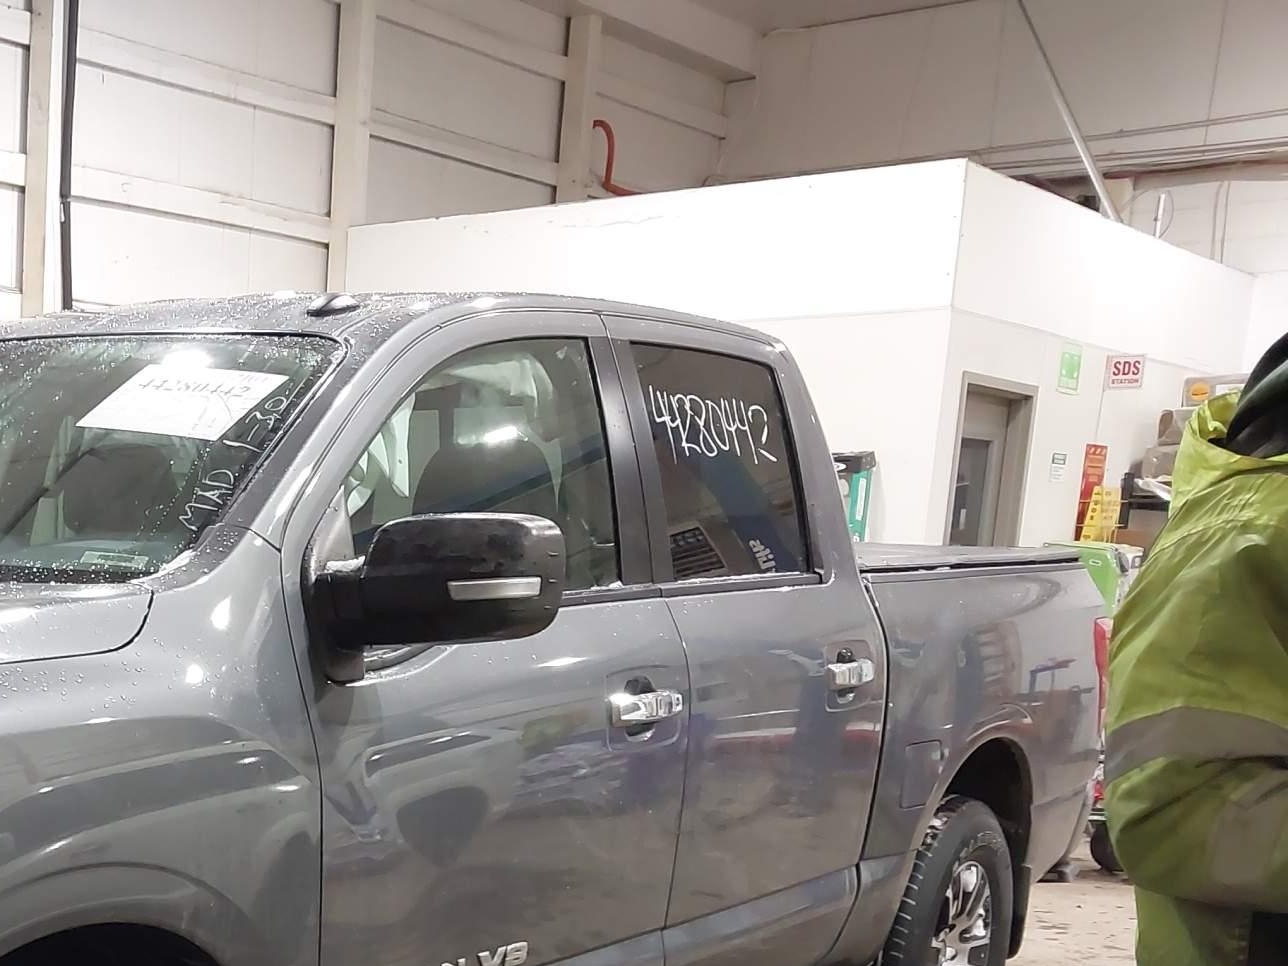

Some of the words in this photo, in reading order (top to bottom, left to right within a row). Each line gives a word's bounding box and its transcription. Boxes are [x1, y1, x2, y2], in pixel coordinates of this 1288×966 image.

[1112, 360, 1141, 376] SDS
[649, 384, 778, 465] 44280442
[179, 469, 234, 531] MAD
